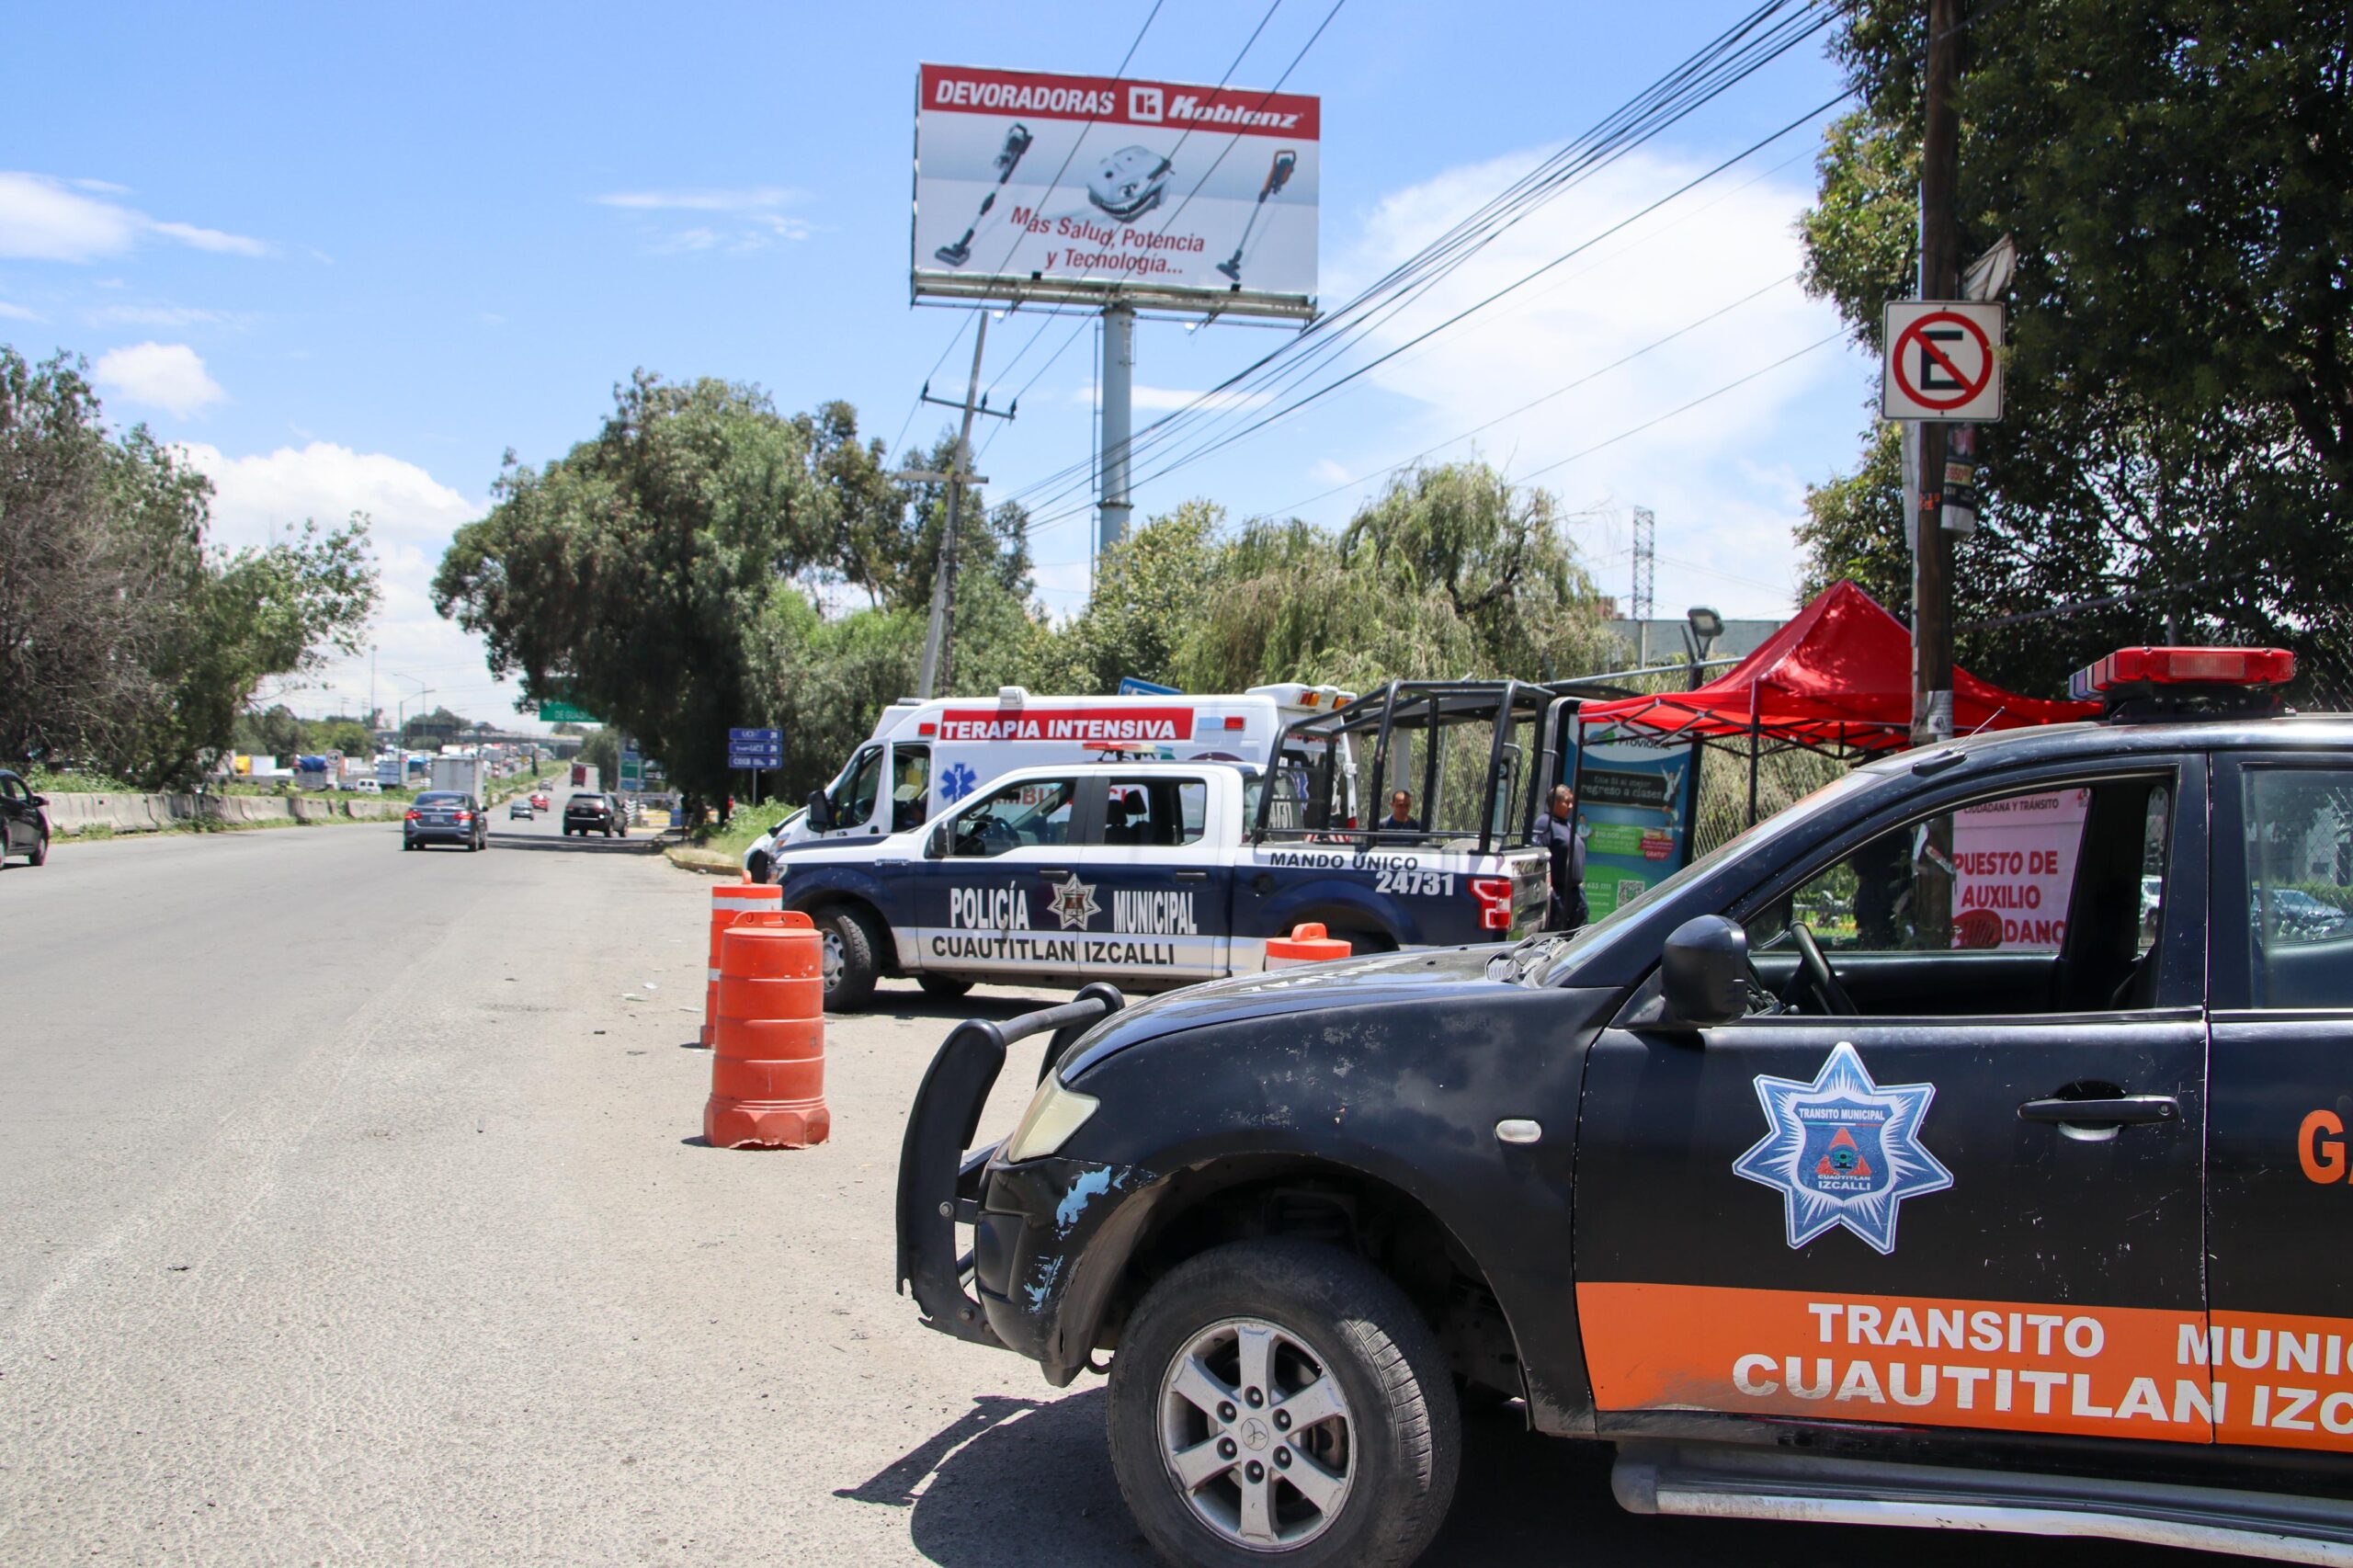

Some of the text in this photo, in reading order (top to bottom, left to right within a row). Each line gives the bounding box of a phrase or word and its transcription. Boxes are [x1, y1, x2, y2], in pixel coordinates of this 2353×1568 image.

[936, 80, 1116, 115] DEVORADORAS
[1167, 95, 1300, 129] Koblenz
[1011, 205, 1205, 252] Más Salud, Potencia
[1045, 248, 1184, 276] y Tecnología...
[943, 719, 1177, 740] TERAPIA INTENSIVA
[1963, 798, 2059, 814] CIUDADANA Y TRÁNSITO
[1269, 851, 1418, 870] MANDO ÚNICO
[1951, 850, 2058, 876] PUESTO DE
[1375, 871, 1454, 896] 24731
[1961, 884, 2041, 910] AUXILIO
[949, 880, 1198, 935] POLICÍA MUNICIPAL
[932, 936, 1175, 965] CUAUTITLAN IZCALLI
[1799, 1108, 1885, 1120] TRANSITO MUNICIPAL
[2298, 1109, 2353, 1185] G
[1818, 1180, 1871, 1190] IZCALLI
[1808, 1302, 2353, 1377] TRANSITO MUNI
[1733, 1354, 2353, 1435] CUAUTITLAN IZC
